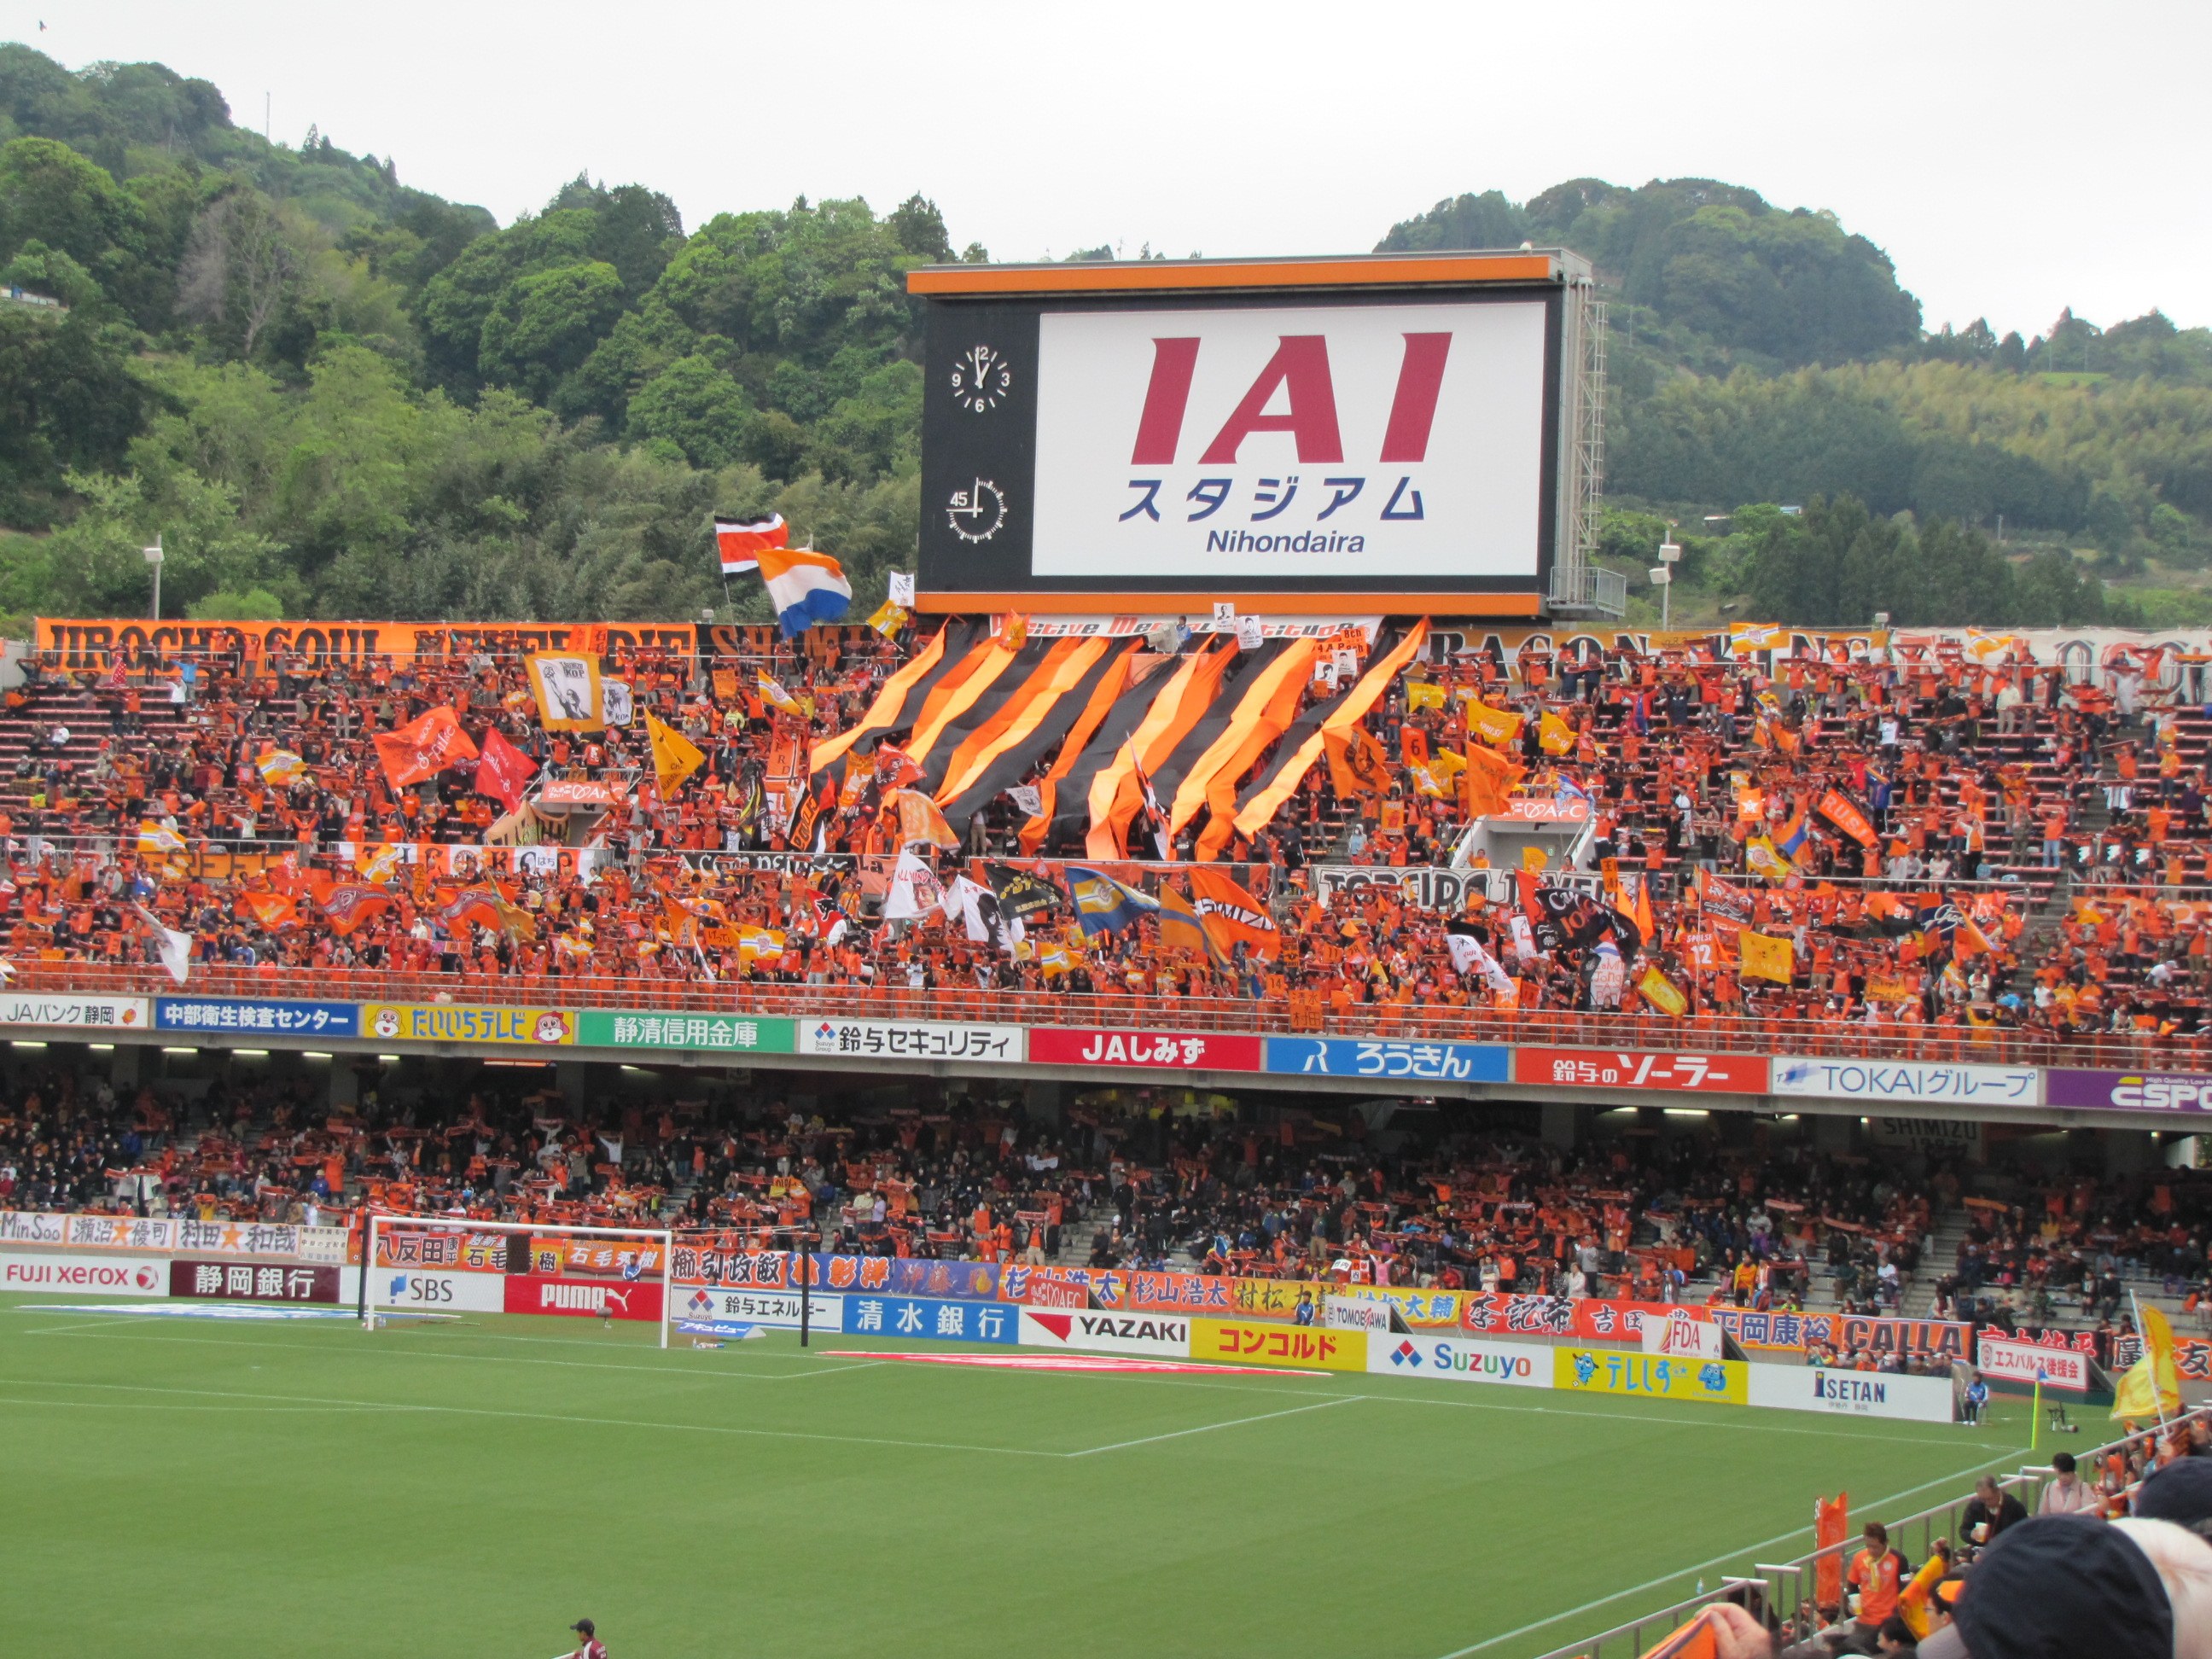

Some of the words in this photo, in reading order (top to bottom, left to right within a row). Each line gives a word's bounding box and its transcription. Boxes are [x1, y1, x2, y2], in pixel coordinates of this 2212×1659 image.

[952, 373, 962, 387] 9
[1001, 372, 1010, 387] 3
[975, 399, 985, 413] 6
[1131, 331, 1454, 465] IAI
[950, 492, 968, 507] 45
[1118, 476, 1425, 523] スタジアム
[1206, 530, 1365, 554] Nihondaira
[1691, 944, 1712, 965] 12
[7, 1004, 114, 1025] JAバンク静岡
[165, 1004, 349, 1029] 中部衛生検査センター
[411, 1009, 527, 1040] だいいちテレビ
[614, 1016, 759, 1048] 静清信用金庫
[838, 1026, 1010, 1057] 鈴与セキュリティ
[1082, 1034, 1206, 1064] JAしみず
[1356, 1042, 1470, 1078] ろうきん
[1553, 1054, 1729, 1087] 鈴与のソーラー
[1820, 1064, 2036, 1097] TOKAIグループ
[181, 1225, 221, 1249] 村田
[246, 1226, 296, 1255] 和哉
[376, 1235, 445, 1265] 八反田
[7, 1264, 52, 1283] FUJI
[57, 1266, 129, 1285] xerox
[195, 1265, 315, 1298] 静岡銀行
[1135, 1273, 1229, 1306] 杉山浩太
[410, 1278, 453, 1302] SBS
[541, 1284, 606, 1309] PUMA
[680, 1322, 749, 1334] アキュビュー
[688, 1313, 713, 1322] Suzuyo
[857, 1300, 1004, 1338] 清水銀行
[1080, 1316, 1187, 1342] YAZAKI
[1710, 1310, 1831, 1348] 平岡康裕
[1219, 1329, 1337, 1360] コンコルド
[1673, 1320, 1700, 1350] FDA
[1434, 1342, 1531, 1379] Suzuyo
[1813, 1371, 1884, 1403] ISETAN
